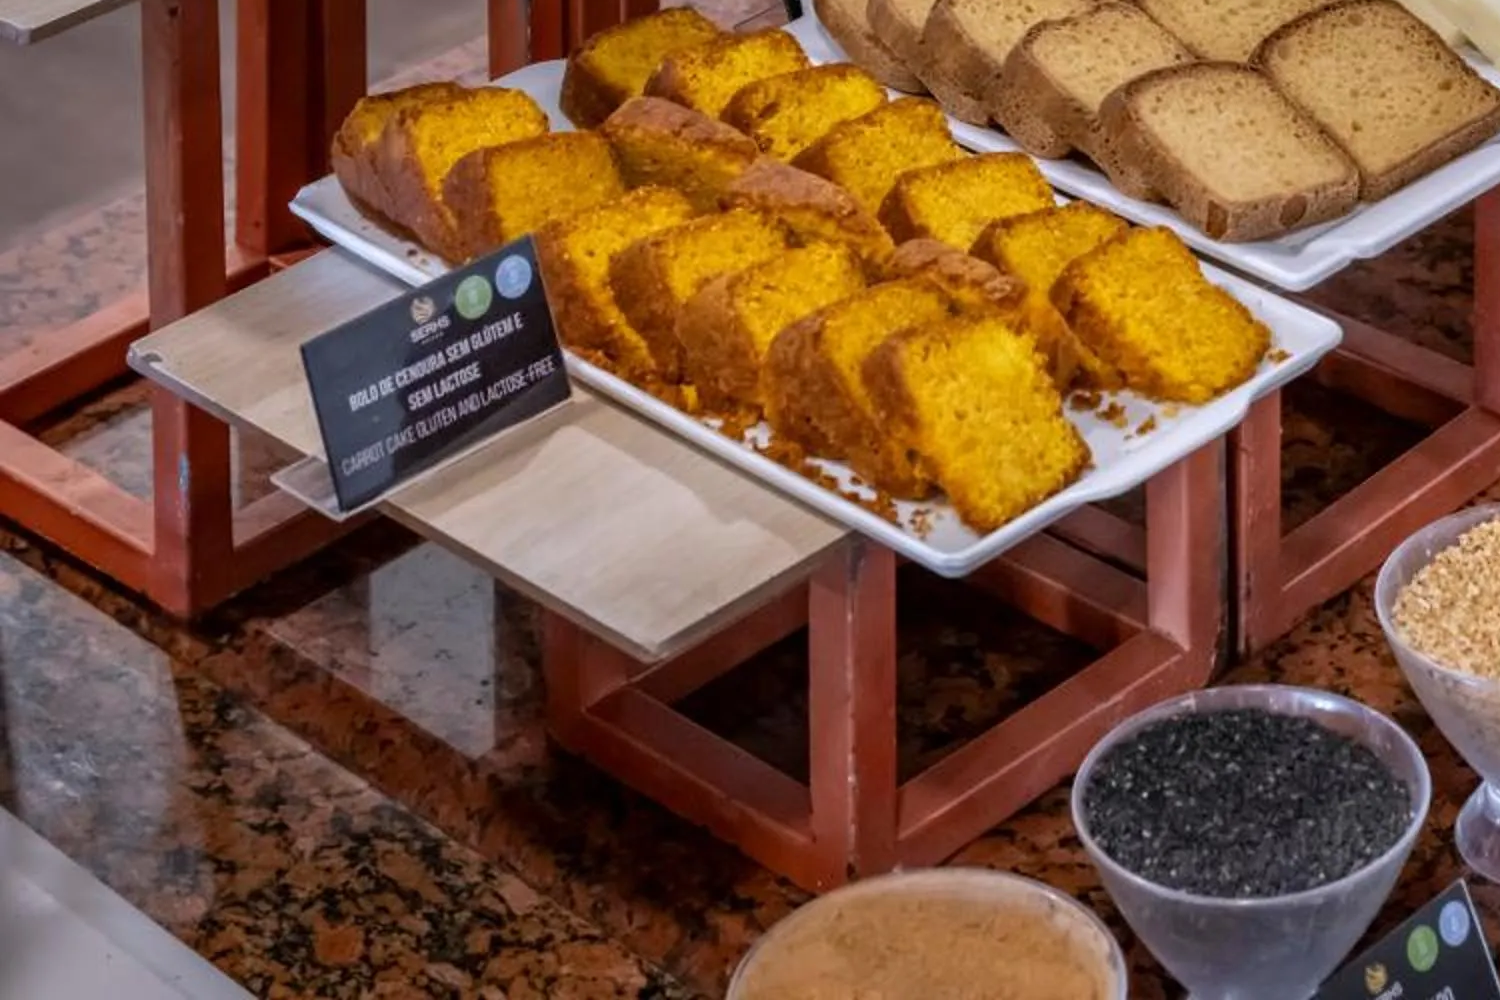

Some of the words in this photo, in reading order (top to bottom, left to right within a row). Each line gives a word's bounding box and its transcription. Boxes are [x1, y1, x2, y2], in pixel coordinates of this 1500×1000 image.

[410, 314, 450, 343] SERHS
[349, 385, 378, 411] BOLO
[379, 377, 395, 395] DE
[395, 351, 445, 387] CENOURA
[446, 339, 469, 362] SEM
[513, 312, 522, 328] E
[407, 386, 432, 410] SEM
[433, 362, 481, 397] LACTOSE
[342, 443, 384, 476] CARROT
[385, 428, 414, 454] CAKE
[416, 406, 456, 438] GLUTEN
[458, 394, 480, 416] AND
